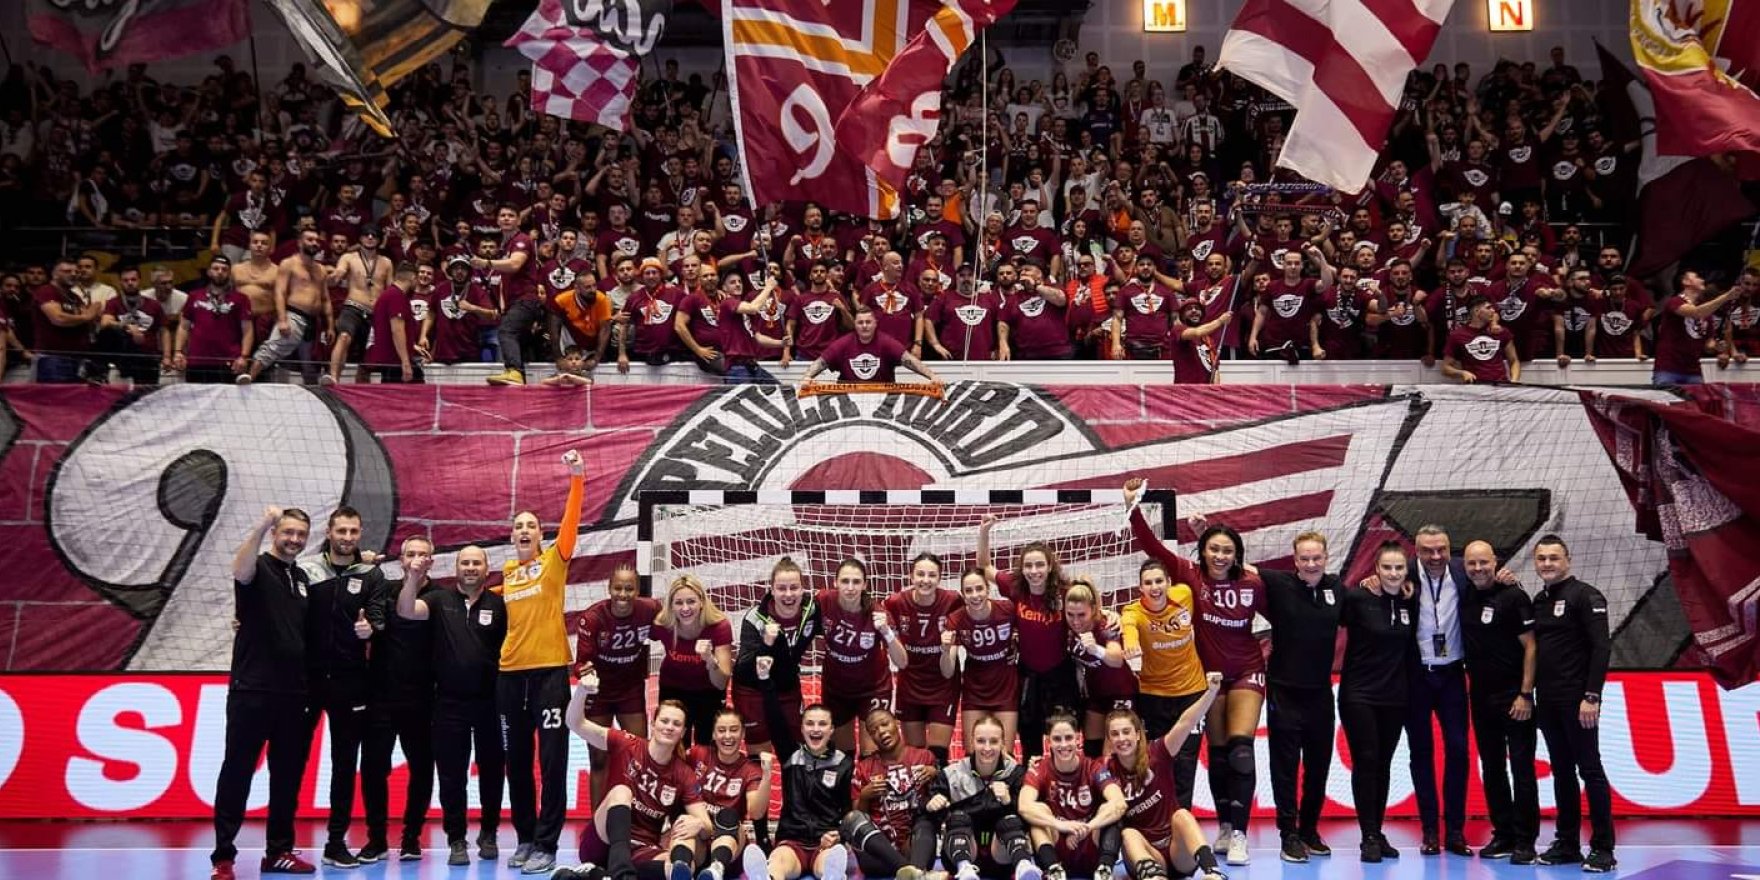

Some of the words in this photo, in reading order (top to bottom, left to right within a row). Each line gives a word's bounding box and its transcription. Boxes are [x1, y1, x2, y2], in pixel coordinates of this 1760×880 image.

[1500, 1, 1523, 26] N
[1213, 589, 1237, 609] 10
[918, 619, 929, 637] 7
[1203, 613, 1248, 627] SUPERBET
[611, 629, 635, 650] 22
[833, 625, 857, 647] 27
[972, 627, 996, 648] 99
[541, 708, 562, 729] 23
[703, 771, 727, 793] 17
